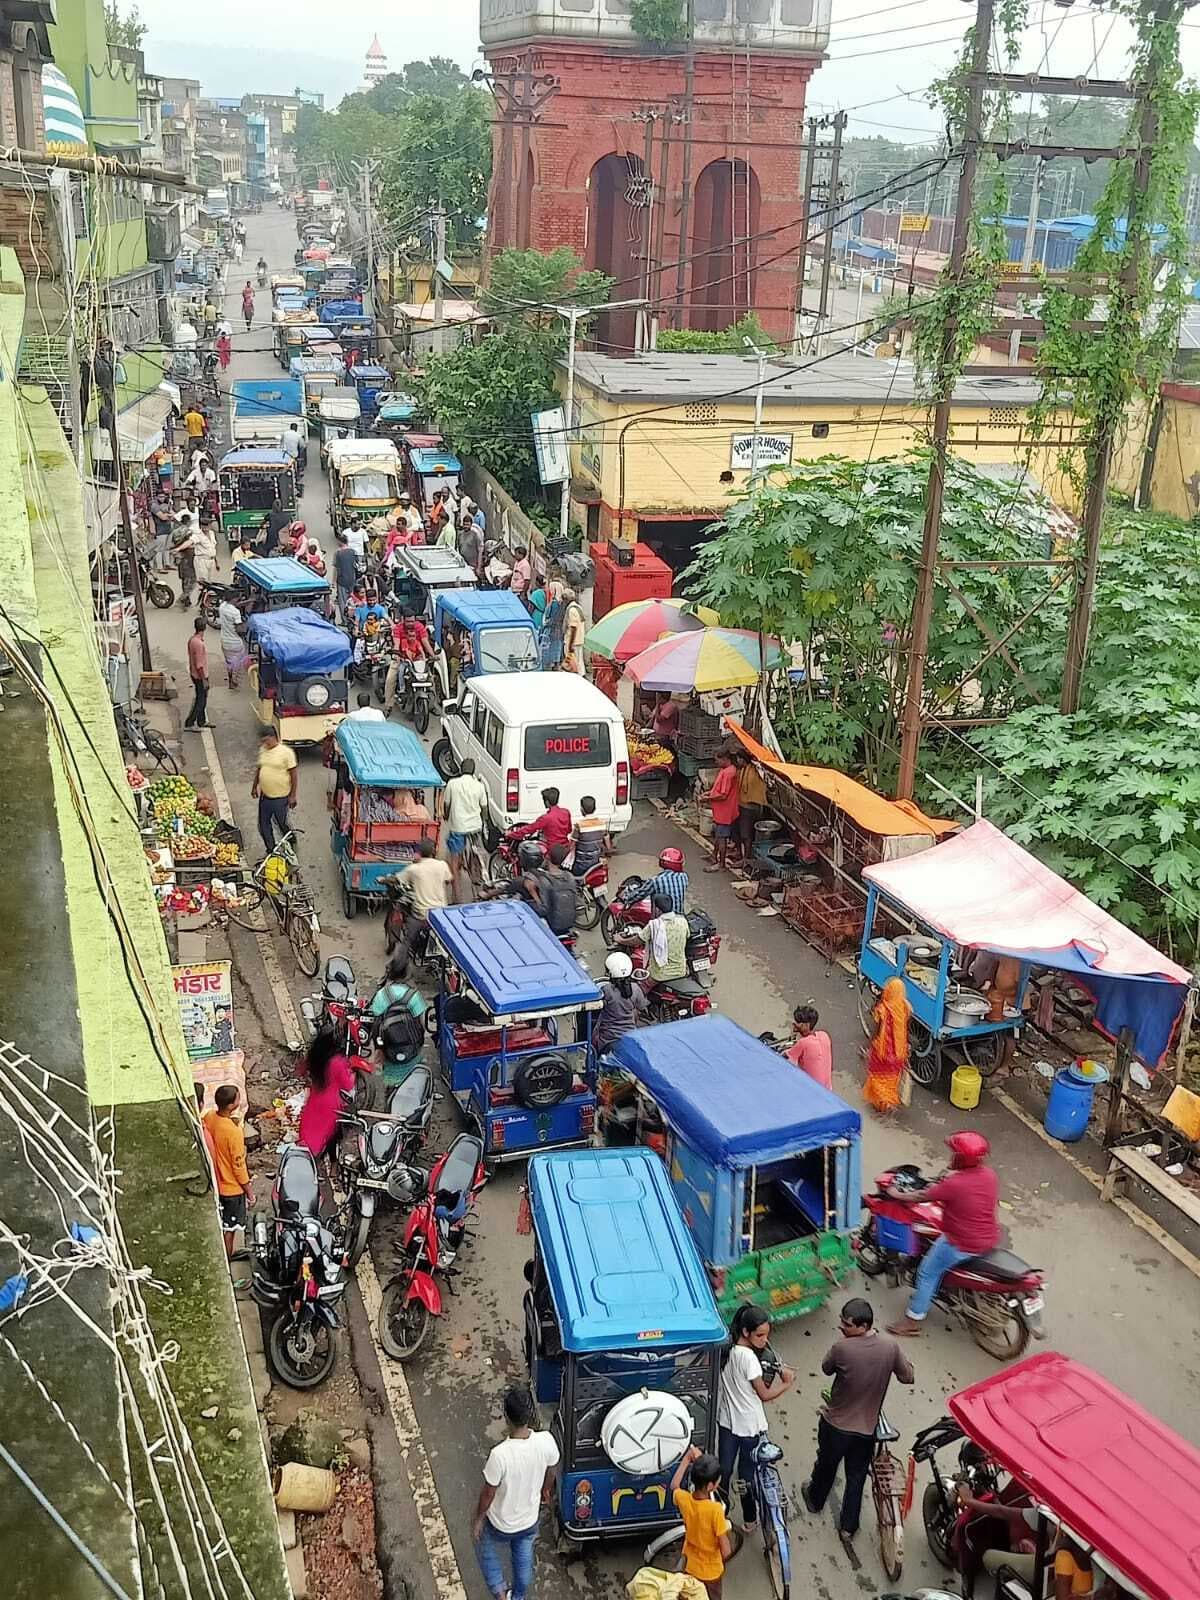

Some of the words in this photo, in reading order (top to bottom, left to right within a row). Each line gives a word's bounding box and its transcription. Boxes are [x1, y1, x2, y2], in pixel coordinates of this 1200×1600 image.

[734, 437, 763, 455] POWR
[764, 437, 791, 455] HOUSE
[545, 737, 591, 753] POLICE
